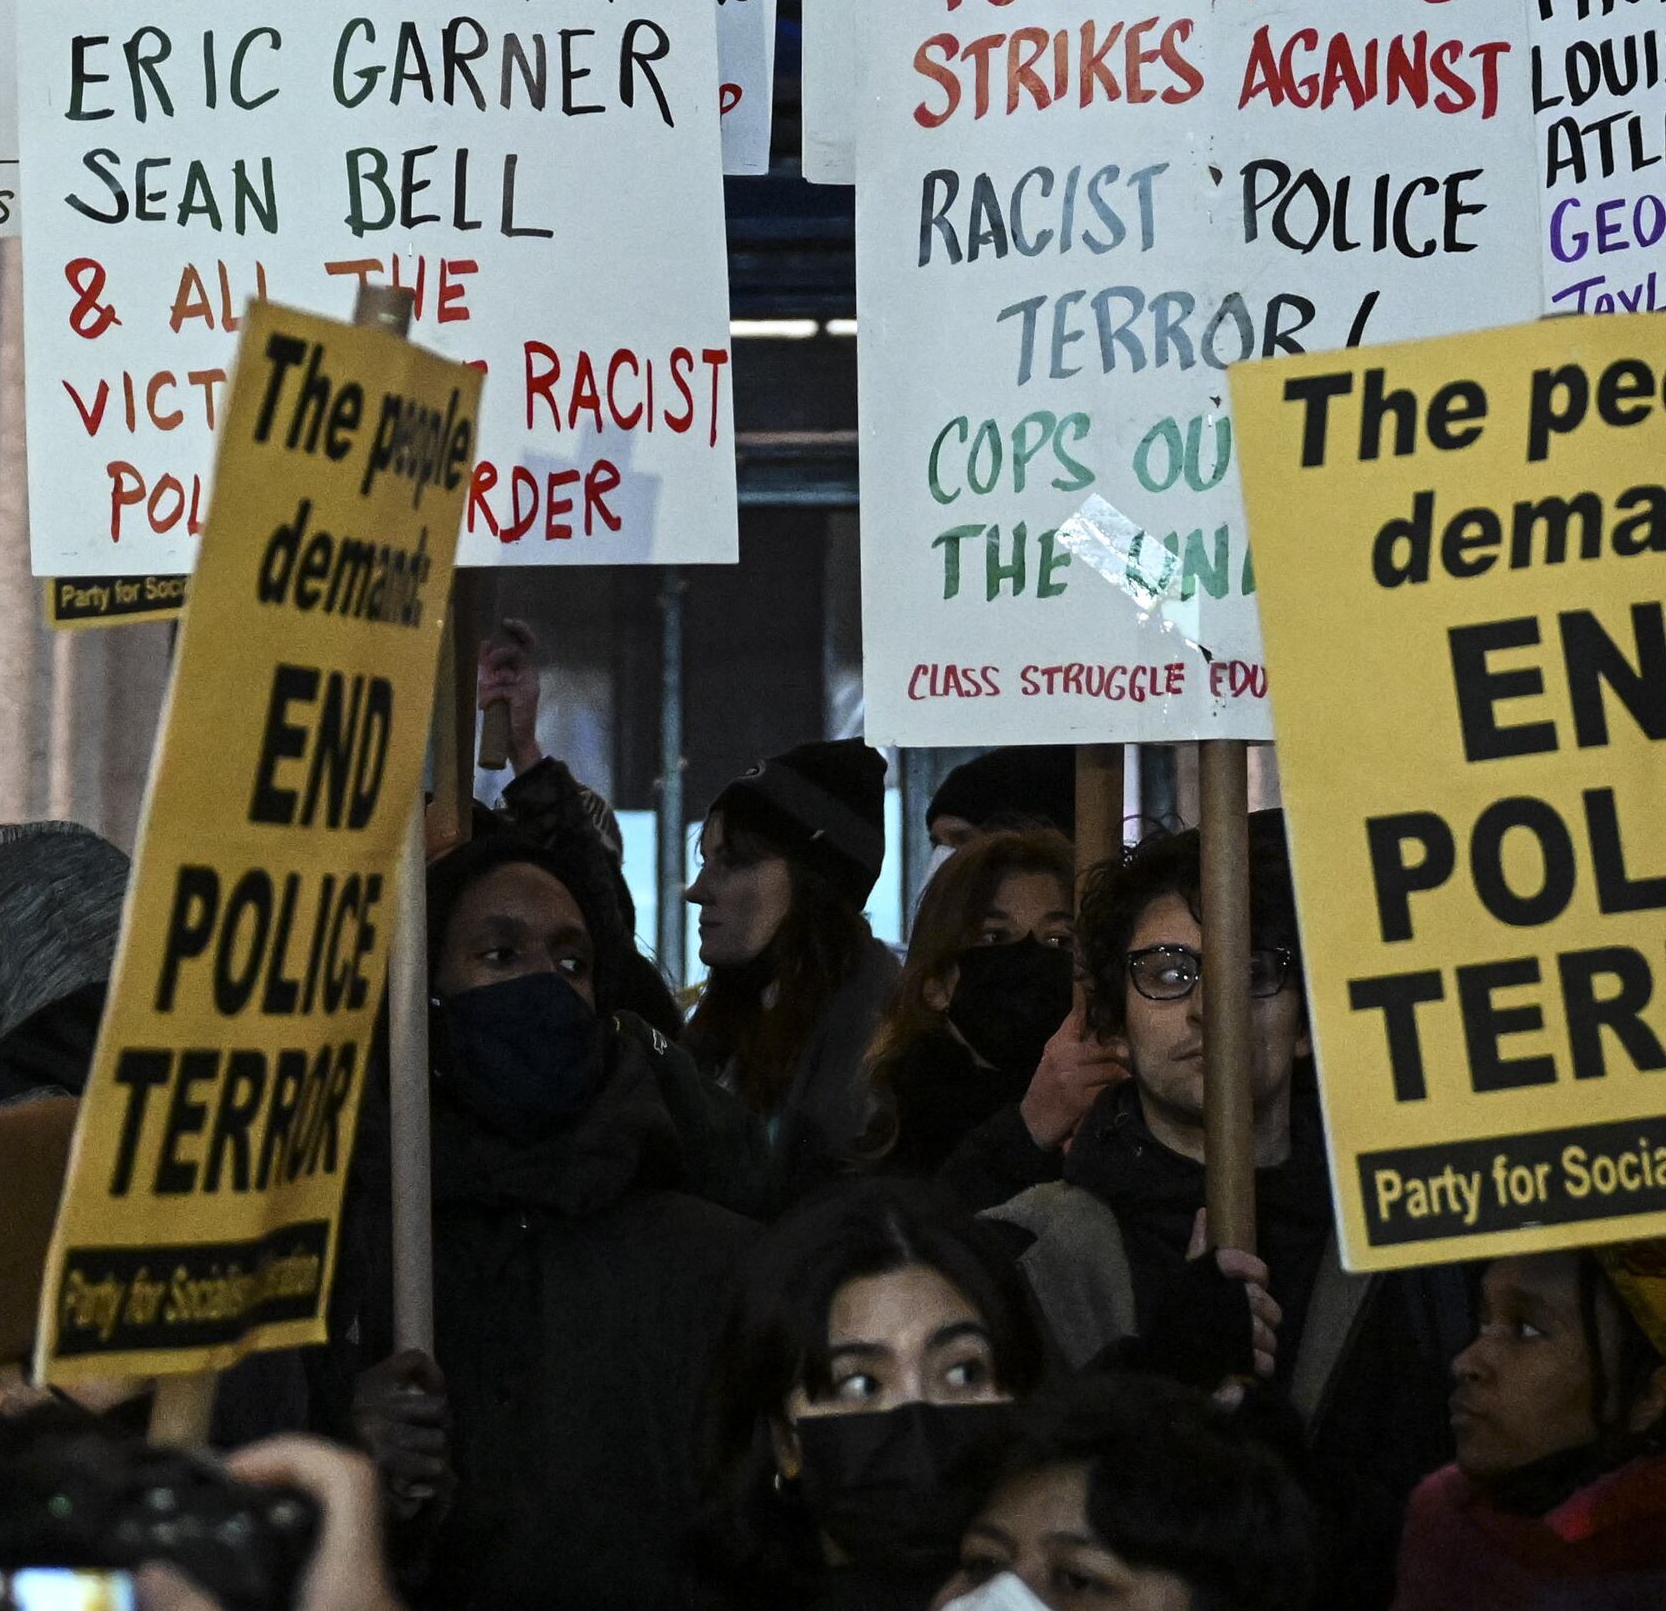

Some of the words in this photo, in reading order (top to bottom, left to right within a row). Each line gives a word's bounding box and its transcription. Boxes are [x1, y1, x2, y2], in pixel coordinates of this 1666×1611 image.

[64, 26, 284, 122] ERIC
[331, 15, 677, 128] GARNER
[911, 16, 1206, 129] STRIKES
[1238, 26, 1512, 120] AGAINST
[64, 147, 279, 235] SEAN
[344, 145, 554, 238] BELL
[918, 161, 1170, 268] RACIST
[1241, 158, 1489, 258] POLICE
[64, 258, 124, 340] &
[63, 368, 228, 436] VICT
[524, 341, 729, 447] RACIST
[253, 332, 364, 462] The
[1283, 368, 1488, 467] The
[108, 462, 204, 544] POL
[469, 460, 624, 543] RDER
[929, 411, 1094, 505] COPS
[1132, 417, 1230, 493] OU
[61, 585, 110, 612] Party
[931, 521, 1070, 603] THE
[908, 664, 1001, 703] CLASS
[1020, 662, 1186, 703] STRUGGLE
[248, 663, 393, 831] END
[154, 864, 384, 1018] POLICE
[110, 1040, 358, 1198] TERROR
[1375, 1164, 1482, 1227] Party
[1491, 1155, 1550, 1209] for
